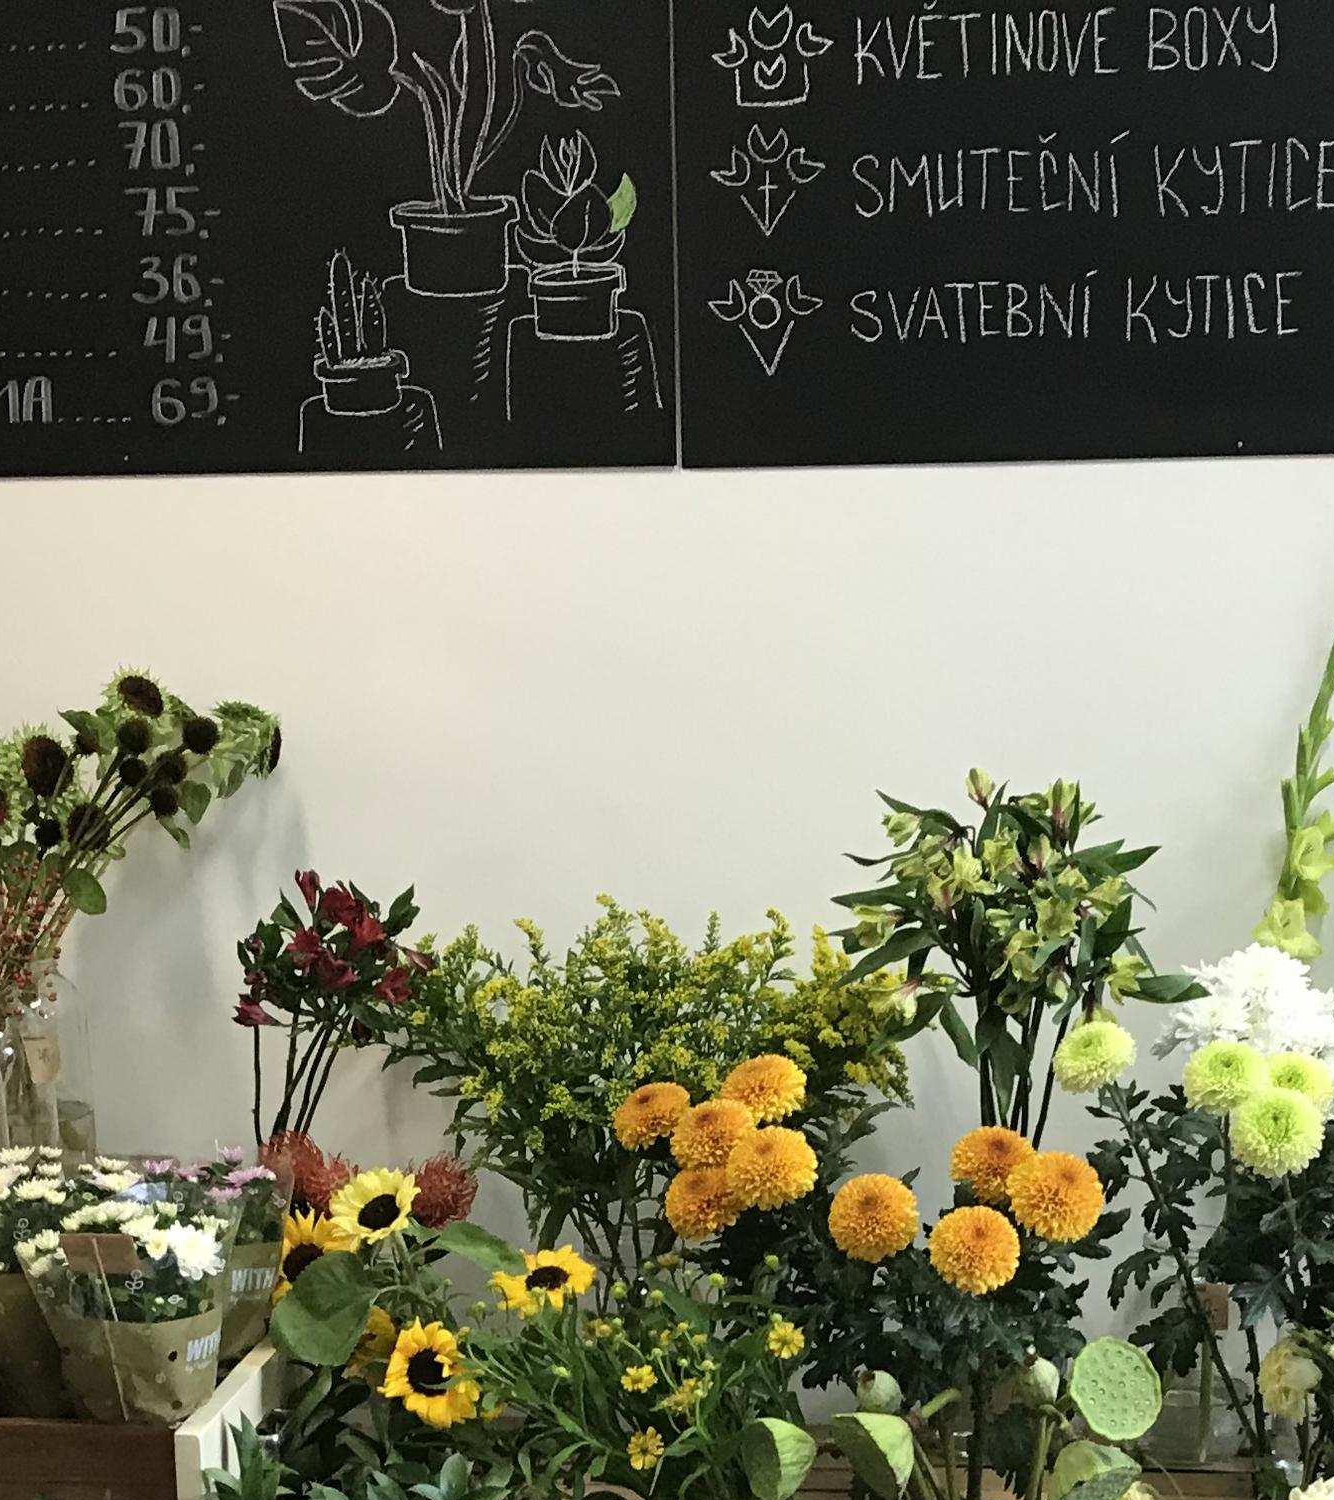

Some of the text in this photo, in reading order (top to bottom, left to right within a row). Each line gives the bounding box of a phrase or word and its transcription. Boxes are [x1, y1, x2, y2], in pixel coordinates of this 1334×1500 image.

[1147, 4, 1279, 73] BOXY
[852, 130, 1130, 219] SMUTEČNÍ
[850, 270, 1304, 344] SVATEBNÍ KYTICE
